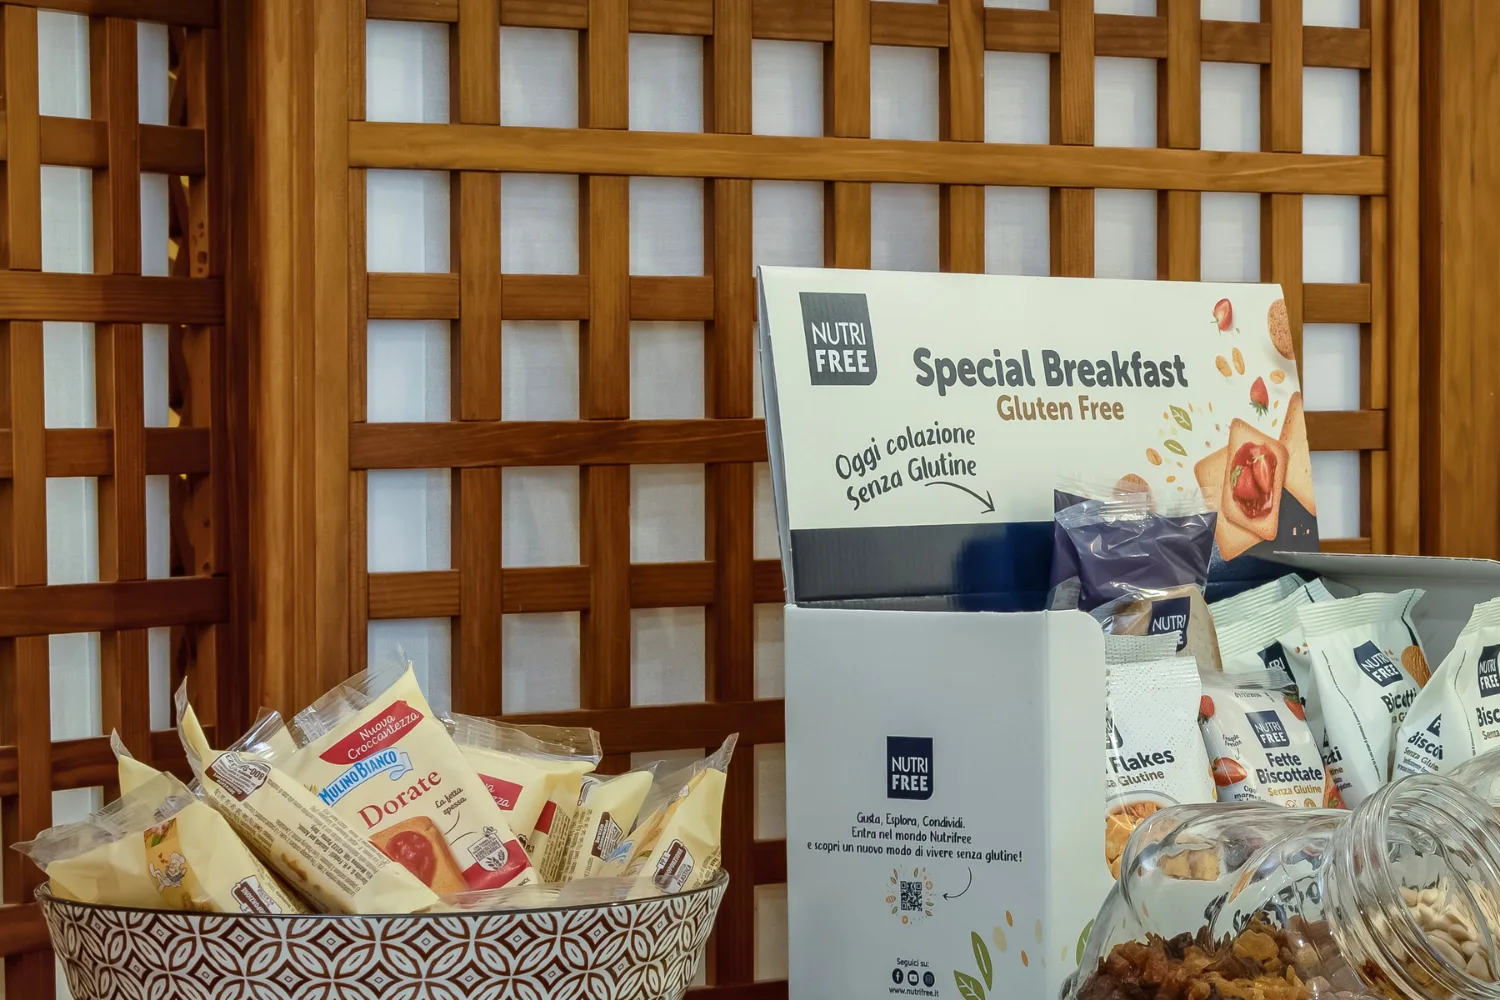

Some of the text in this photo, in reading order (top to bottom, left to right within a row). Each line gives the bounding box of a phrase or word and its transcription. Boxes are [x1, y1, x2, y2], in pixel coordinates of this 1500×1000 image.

[811, 321, 867, 346] NUTRI
[815, 349, 870, 373] FREE
[912, 347, 1189, 397] Special Breakfast
[996, 394, 1125, 421] Gluten Free
[835, 420, 976, 480] Oggi colazione
[846, 451, 977, 511] Senza Glutine
[1152, 614, 1187, 632] NUTRI
[1360, 651, 1390, 671] NUTRI
[1478, 658, 1497, 676] NUTRI
[1371, 661, 1400, 683] FREE
[1479, 673, 1500, 691] FREE
[347, 711, 420, 761] Croccantezza
[358, 713, 396, 742] Nuova
[1254, 721, 1283, 733] NUTRI
[1259, 732, 1287, 744] FREE
[891, 756, 928, 773] NUTRI
[1109, 749, 1176, 775] Flakes
[1265, 752, 1303, 768] Fette
[317, 770, 359, 806] MULINO
[354, 750, 398, 779] BIANCO
[892, 774, 929, 791] FREE
[1118, 768, 1166, 788] Glutine
[1255, 767, 1324, 785] Biscottate
[356, 771, 443, 830] Dorate
[1267, 785, 1293, 797] Senza
[1293, 785, 1323, 796] Glutine
[856, 812, 966, 829] Gusta, Esplora, Condividi.
[851, 826, 972, 844] Entra nel mondo Nutrifree
[807, 840, 1023, 864] e scopri un nuovo modo di vivere senza glutine!
[896, 957, 919, 968] Seguici
[889, 987, 940, 998] www.nutrifree.it
